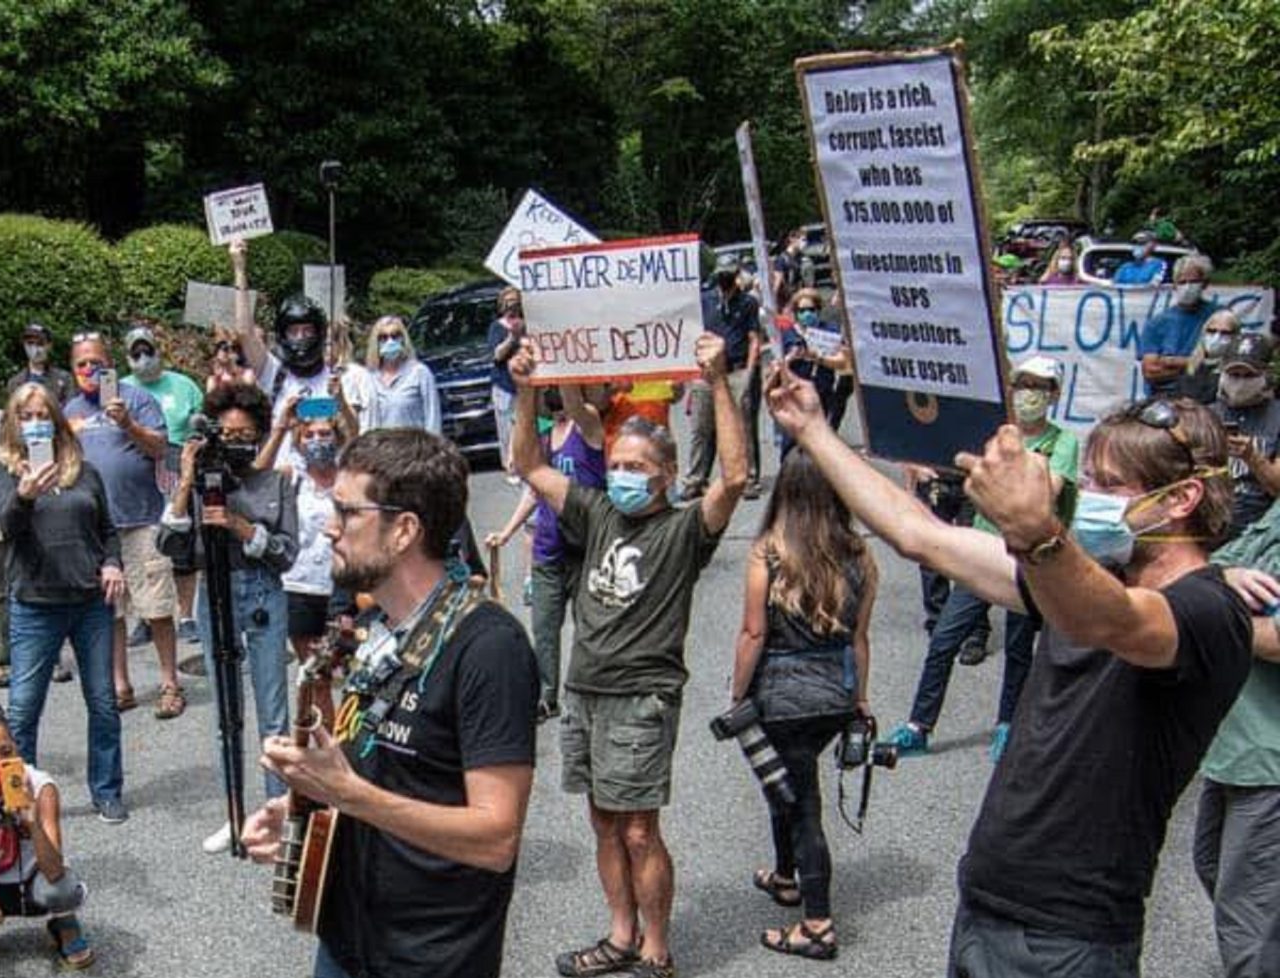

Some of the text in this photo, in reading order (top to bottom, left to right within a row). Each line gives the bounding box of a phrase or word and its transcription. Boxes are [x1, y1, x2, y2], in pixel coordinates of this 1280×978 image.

[870, 87, 885, 110] is
[887, 89, 897, 109] a
[889, 124, 946, 149] fascist
[859, 163, 923, 187] who has
[843, 201, 955, 225] $75,000,000 of
[520, 253, 613, 292] DELIVER
[946, 252, 963, 274] in
[889, 285, 931, 309] USPS
[880, 355, 968, 385] SAVE USPS!!
[400, 690, 419, 712] IS
